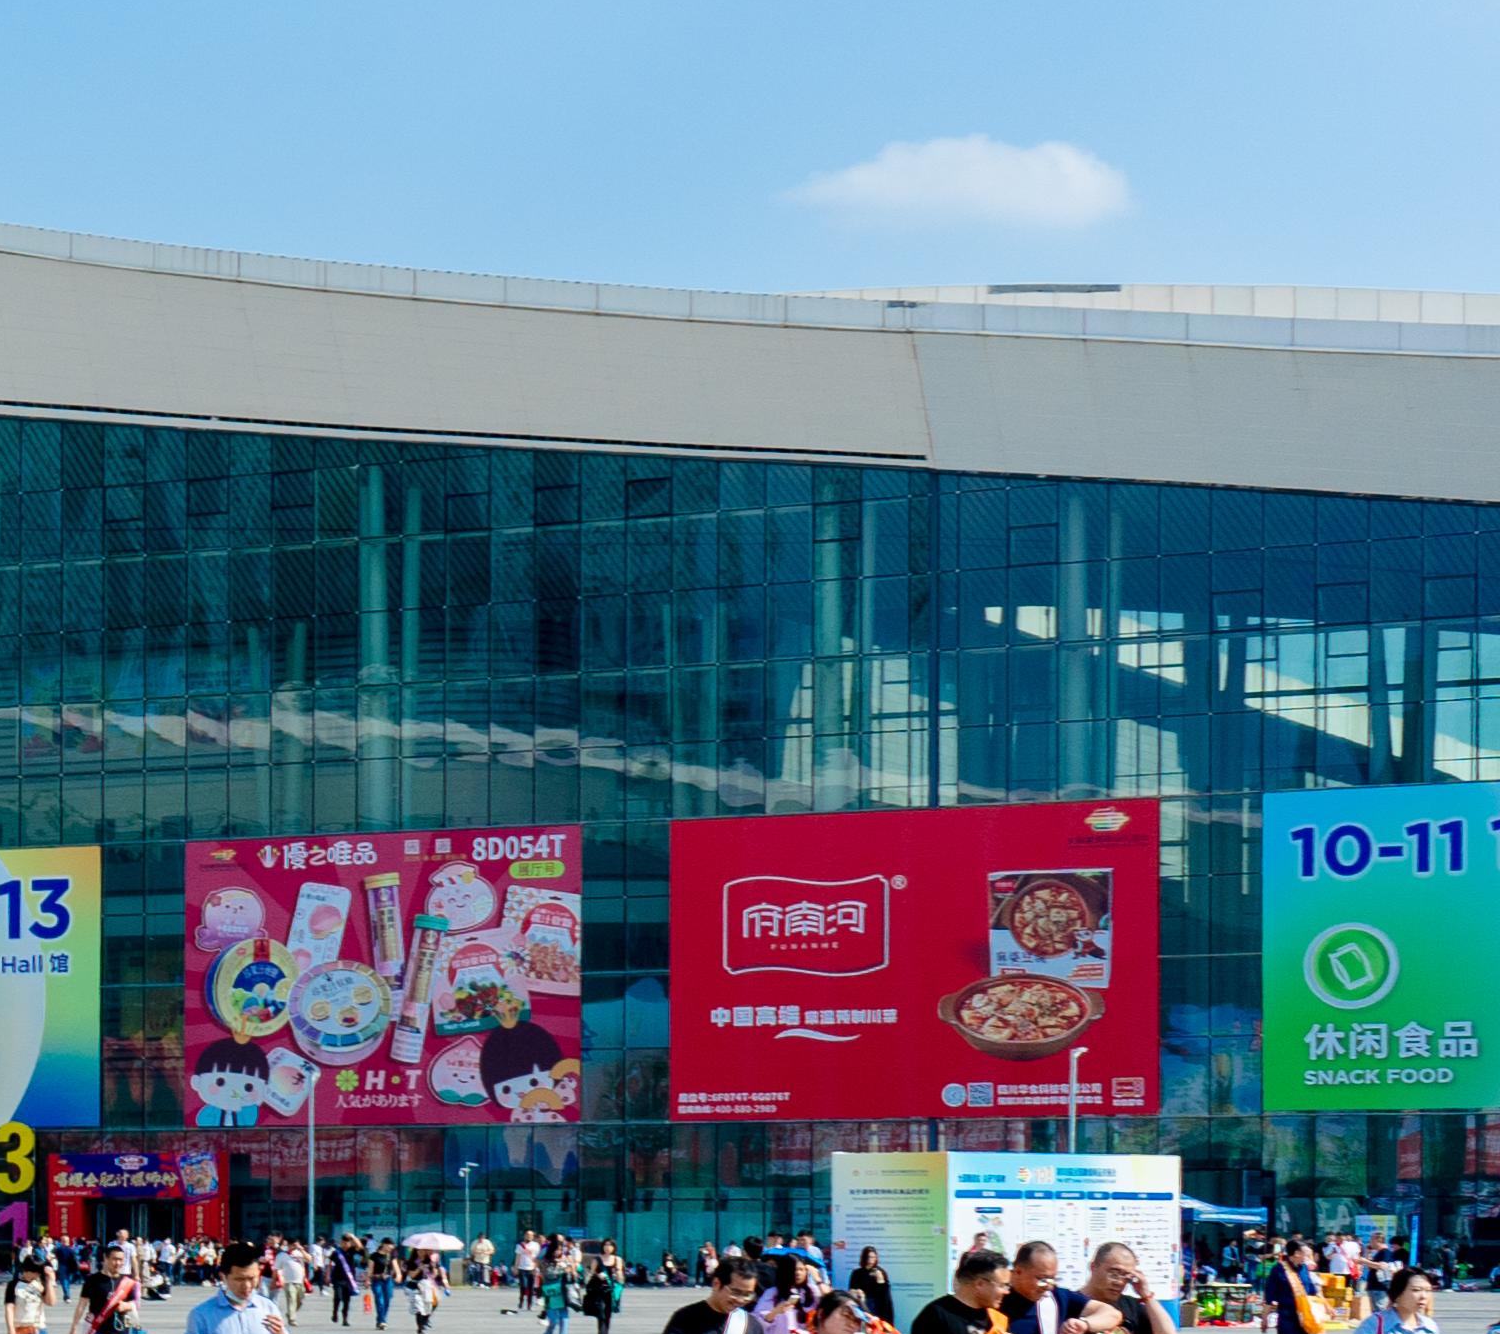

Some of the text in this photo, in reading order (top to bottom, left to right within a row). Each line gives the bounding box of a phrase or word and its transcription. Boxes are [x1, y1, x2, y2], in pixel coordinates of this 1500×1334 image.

[472, 834, 567, 861] 8D054T
[1290, 819, 1464, 878] 10-11
[742, 899, 868, 938] 府南河
[1, 954, 71, 974] Hall 馆
[1304, 1021, 1479, 1060] 休闲食品
[1304, 1068, 1454, 1085] SNACK FOOD
